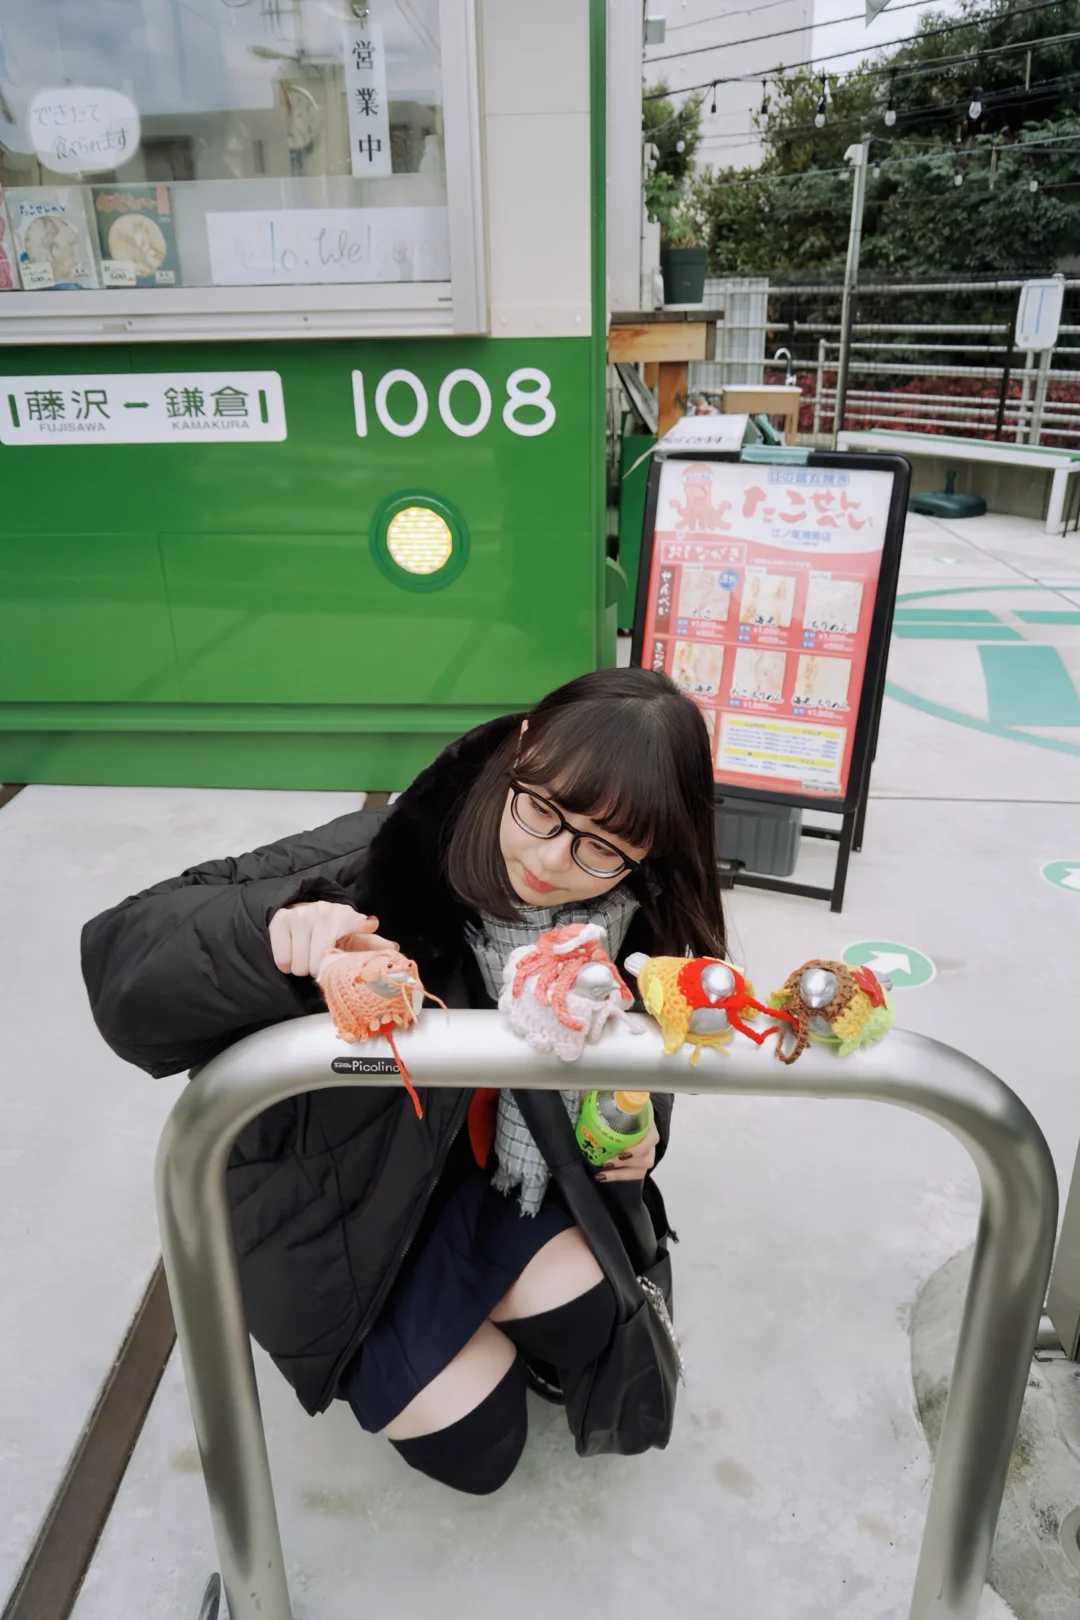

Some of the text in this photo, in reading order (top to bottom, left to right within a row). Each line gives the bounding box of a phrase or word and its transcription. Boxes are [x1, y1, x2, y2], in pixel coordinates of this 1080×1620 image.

[352, 40, 382, 162] 営業中
[25, 384, 250, 422] 藤沢 鎌倉
[39, 418, 251, 434] FUJISAWA KAMAKURA
[351, 366, 556, 438] 1008
